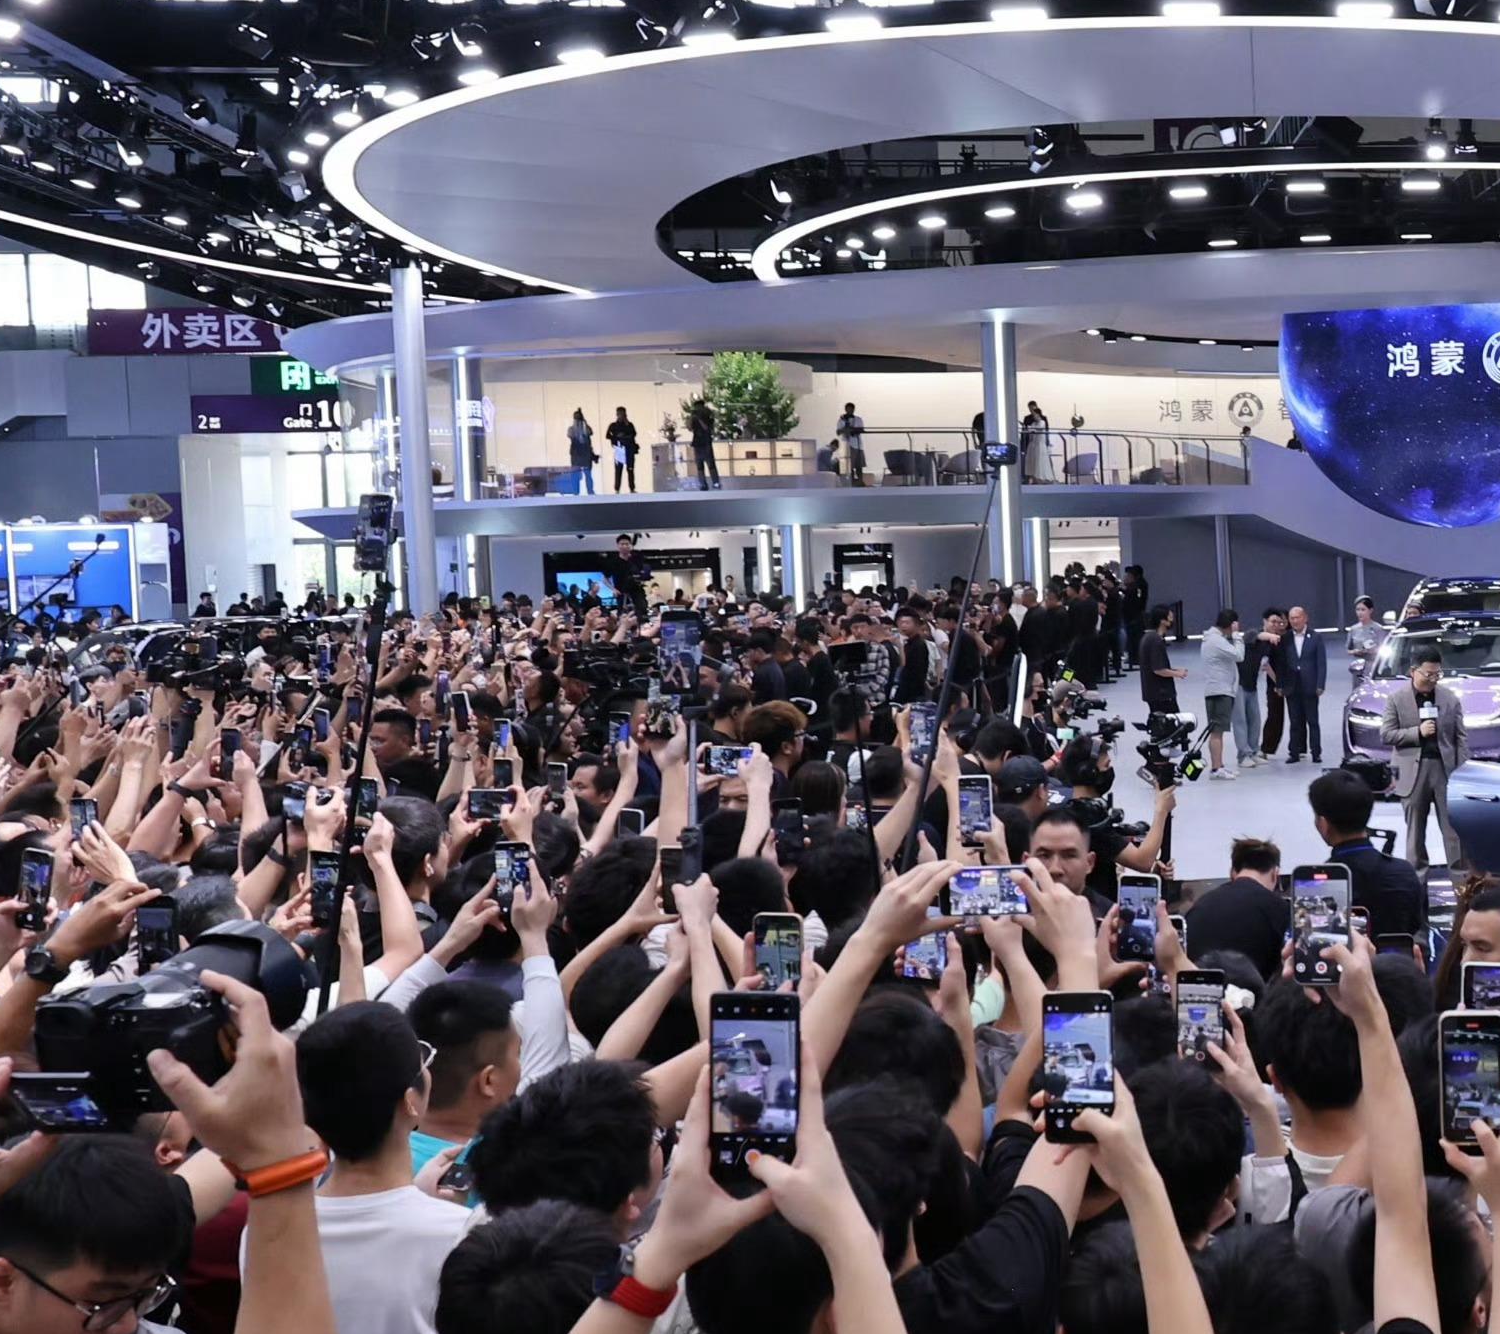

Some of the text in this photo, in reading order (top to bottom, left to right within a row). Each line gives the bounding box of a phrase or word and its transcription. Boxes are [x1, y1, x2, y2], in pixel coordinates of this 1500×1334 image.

[141, 314, 262, 349] 外卖区
[1387, 342, 1465, 377] 鸿蒙
[1159, 398, 1213, 422] 鸿蒙
